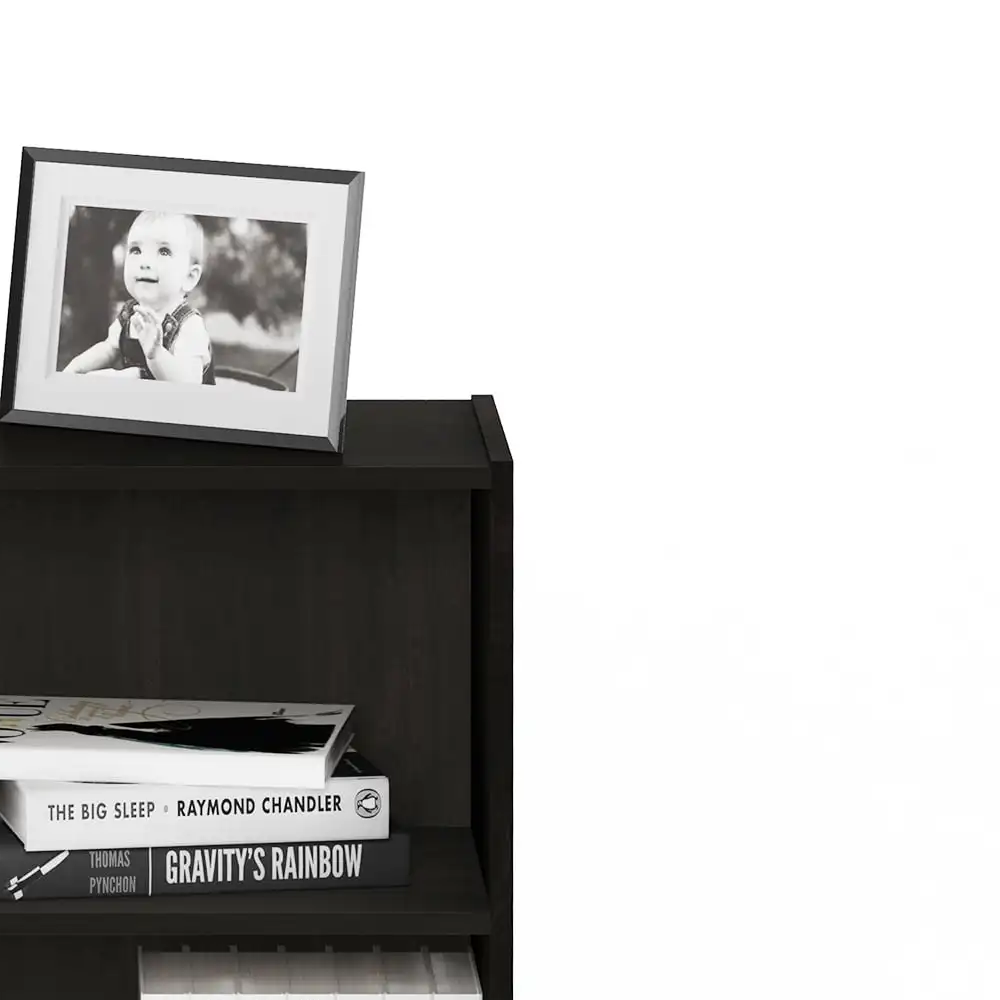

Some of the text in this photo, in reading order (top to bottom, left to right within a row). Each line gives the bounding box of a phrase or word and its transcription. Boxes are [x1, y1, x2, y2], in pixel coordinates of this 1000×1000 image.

[48, 794, 342, 821] THE BIG SLEEP RAYMOND CHANDLER
[88, 850, 131, 869] THOMAS
[165, 844, 364, 885] GRAVITY'S RAINBOW
[88, 876, 137, 894] PYNCHON
